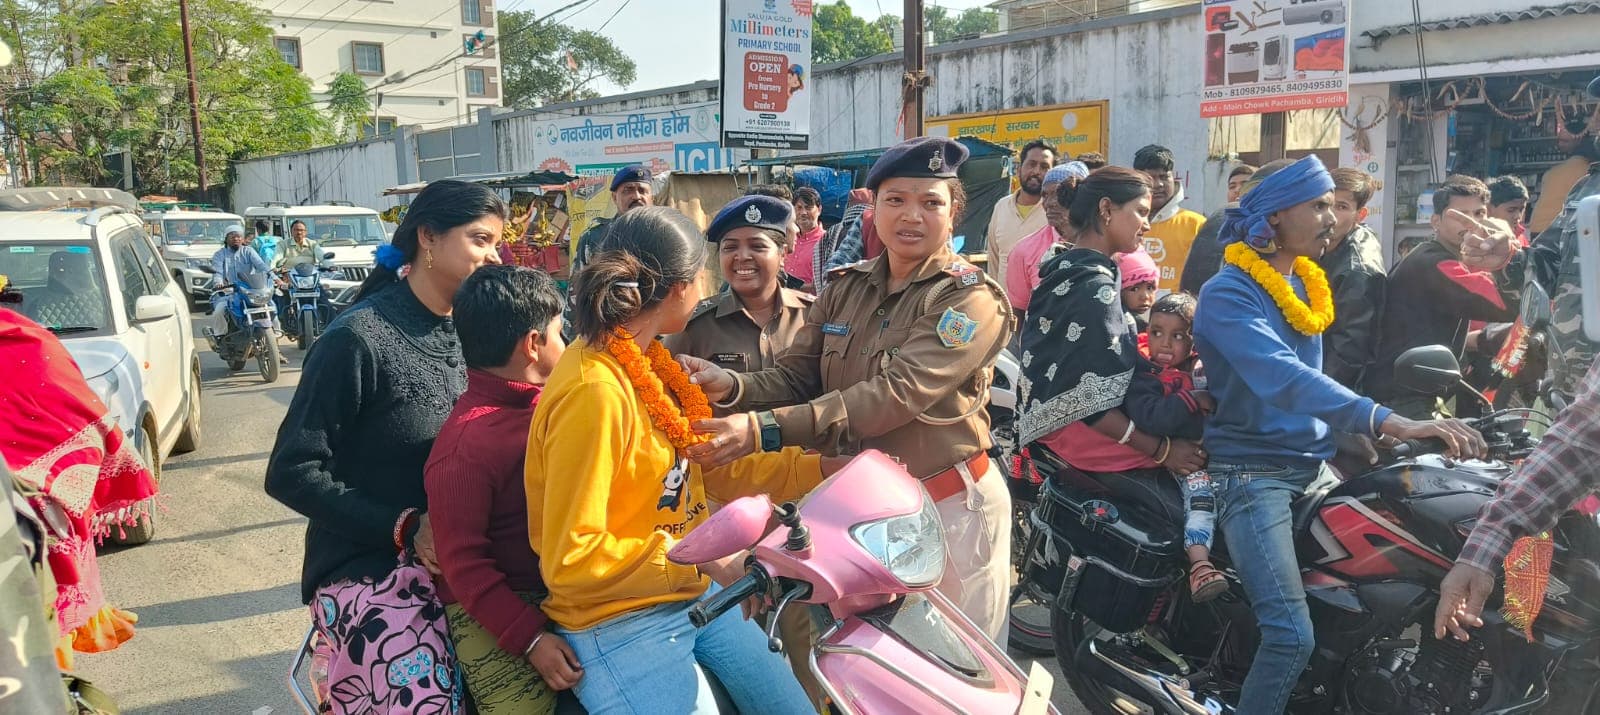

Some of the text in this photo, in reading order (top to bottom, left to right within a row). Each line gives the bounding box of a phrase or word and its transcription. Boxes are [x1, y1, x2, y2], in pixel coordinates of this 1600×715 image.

[731, 19, 809, 38] Millimeters
[738, 38, 801, 52] PRIMARY SCHOOL
[748, 54, 784, 63] ADMISSION
[749, 62, 782, 73] OPEN
[758, 74, 773, 82] from
[759, 83, 782, 93] Nursery
[1204, 90, 1223, 99] Mob
[1286, 79, 1343, 92] 8409495830
[753, 101, 771, 110] Grade
[1202, 105, 1217, 113] Add
[1223, 103, 1242, 111] Main
[1243, 101, 1270, 109] Chowk
[1315, 95, 1344, 104] Giridih
[560, 119, 613, 143] नवजीवन
[616, 114, 658, 138] नर्सिंग
[1006, 119, 1041, 132] सरकार
[1064, 133, 1088, 144] विभाग
